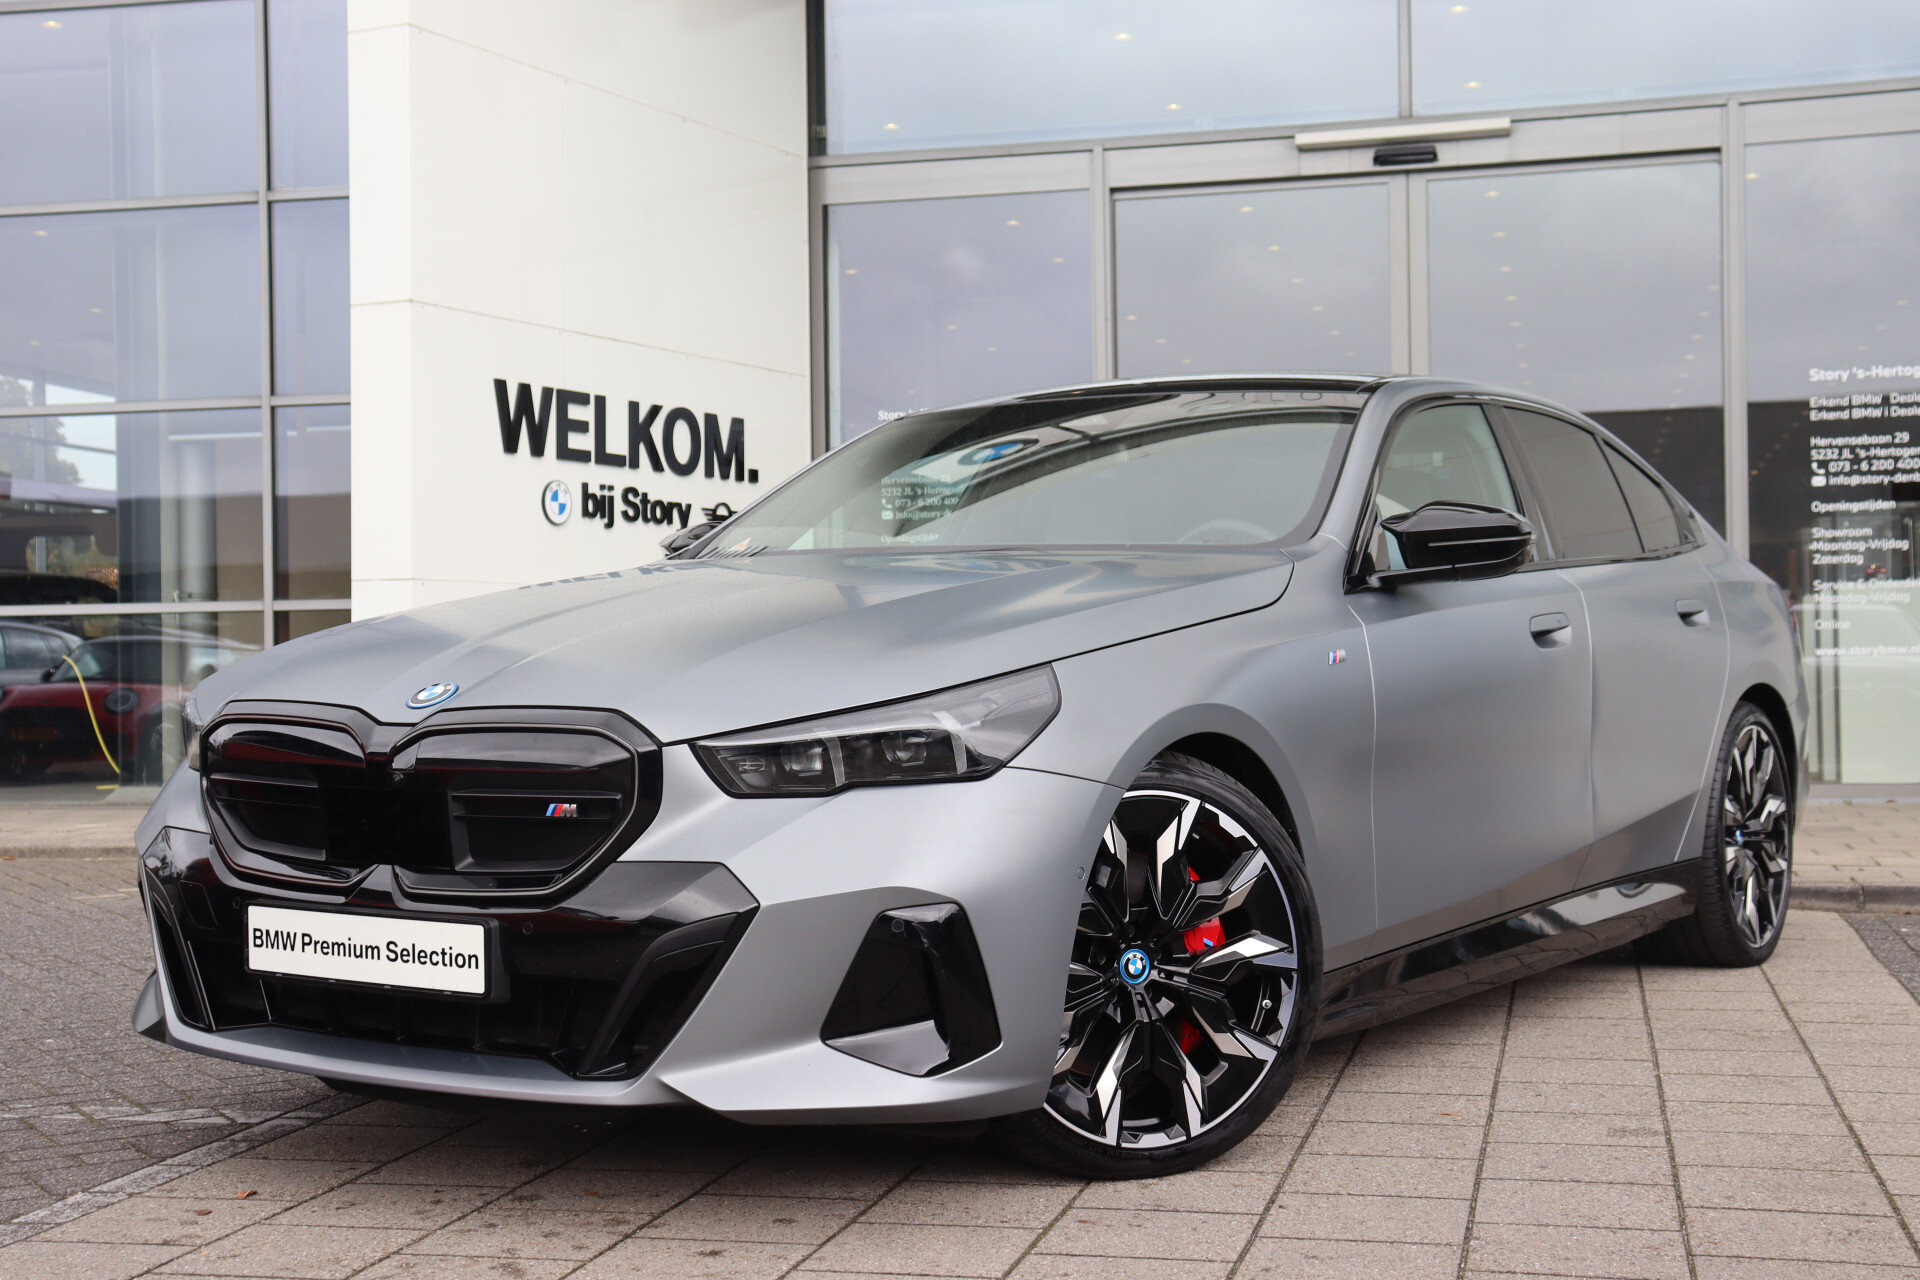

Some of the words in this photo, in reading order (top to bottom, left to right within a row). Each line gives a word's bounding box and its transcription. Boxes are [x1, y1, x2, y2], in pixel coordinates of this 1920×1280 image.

[1808, 368, 1850, 383] Story
[1809, 396, 1850, 408] Erkend
[1851, 393, 1883, 406] BMW
[1809, 408, 1850, 421] Erkend
[1851, 406, 1883, 419] BMW
[493, 377, 759, 483] WELKOM.
[1810, 434, 1893, 447] Hervensebaan
[1893, 431, 1910, 443] 29
[1810, 448, 1839, 460] 5232
[1840, 447, 1854, 459] JL
[1828, 460, 1851, 473] 073
[1860, 459, 1870, 471] 6
[1870, 458, 1895, 471] 200
[1896, 457, 1920, 469] 400
[581, 482, 614, 529] bij
[621, 486, 692, 529] Story
[1811, 499, 1896, 514] Openingstijden
[1812, 527, 1873, 539] Showroom
[1811, 537, 1909, 552] Maandag-Vrijdag
[1812, 553, 1864, 565] Zaterdag
[1813, 579, 1855, 591] Service
[253, 928, 297, 952] BMW
[301, 932, 381, 961] Premium
[386, 940, 479, 970] Selection
